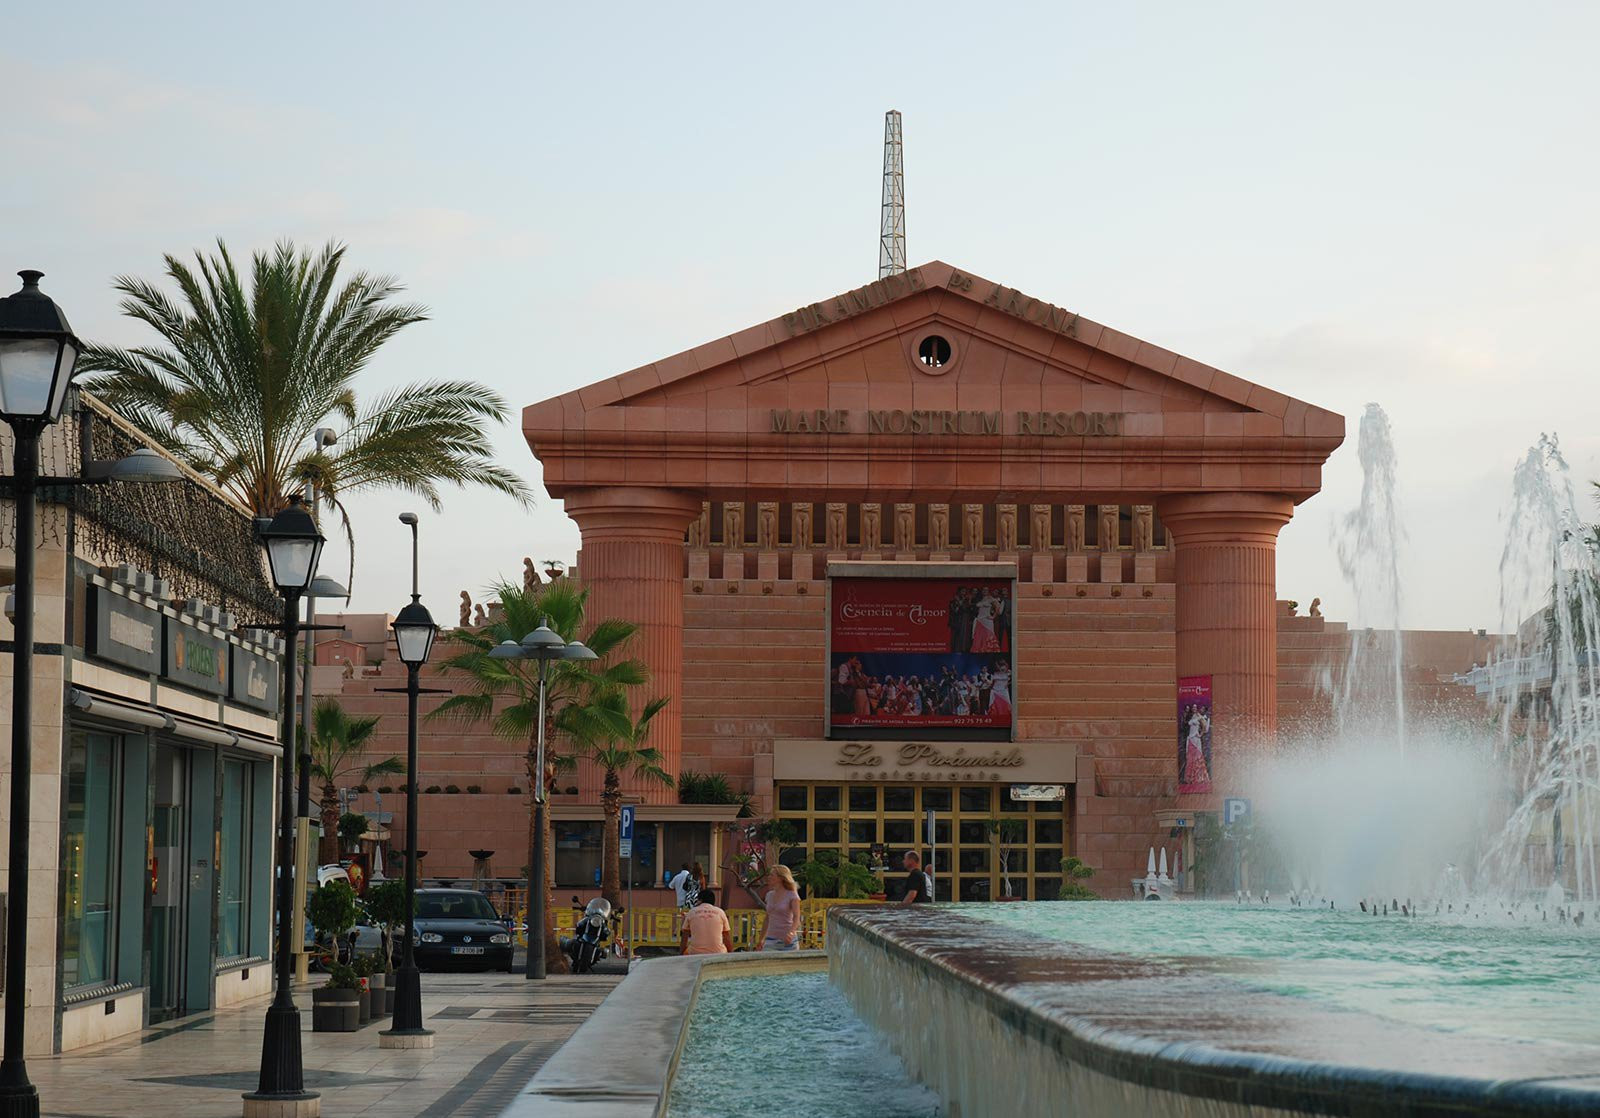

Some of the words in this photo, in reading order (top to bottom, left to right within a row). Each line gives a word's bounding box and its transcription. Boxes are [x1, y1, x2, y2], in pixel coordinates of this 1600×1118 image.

[983, 283, 1080, 338] ARONA
[770, 409, 850, 434] MARE
[867, 409, 1000, 436] NOSTRUM
[1016, 411, 1127, 437] RESORT
[841, 603, 893, 621] Esencia
[908, 604, 947, 625] Amor
[837, 743, 883, 767] La
[850, 770, 1001, 782] restaurante
[622, 809, 631, 837] P
[1229, 800, 1247, 822] P
